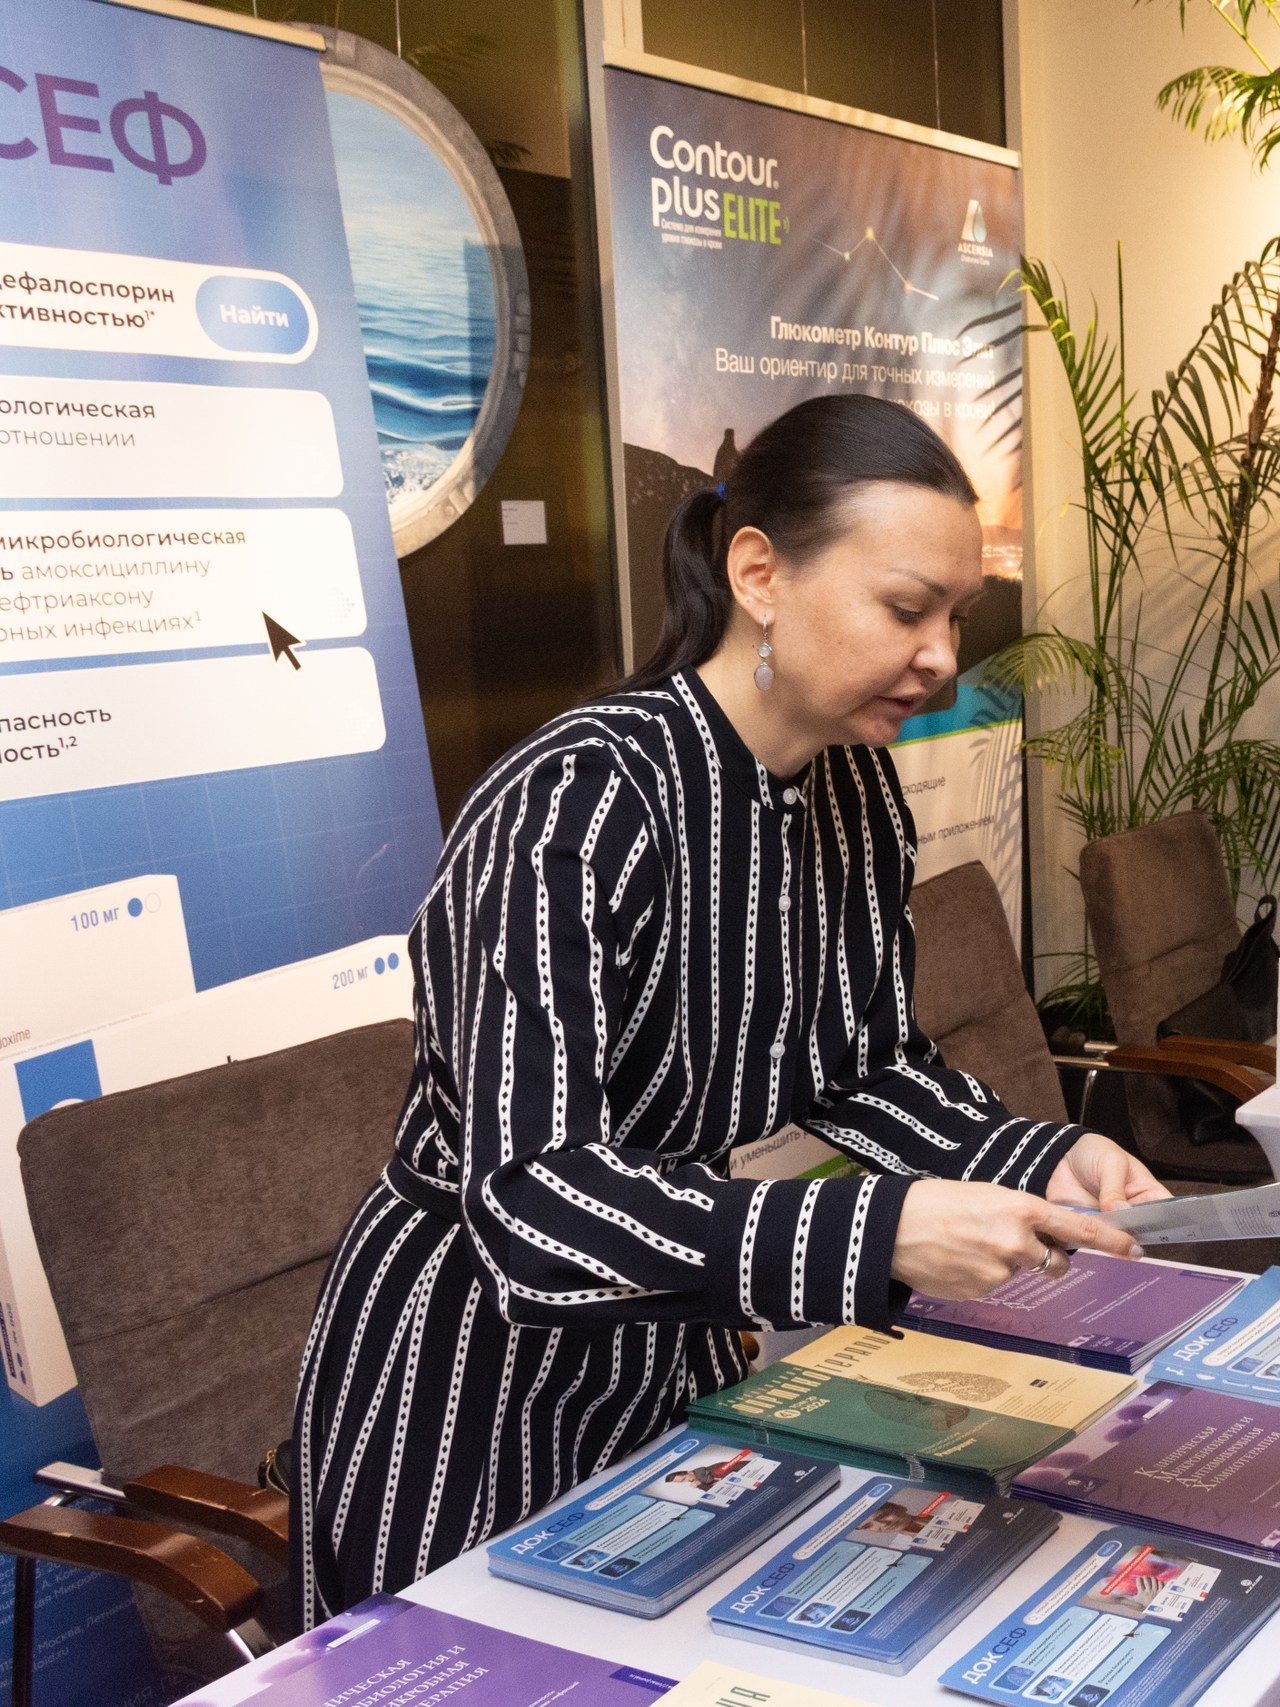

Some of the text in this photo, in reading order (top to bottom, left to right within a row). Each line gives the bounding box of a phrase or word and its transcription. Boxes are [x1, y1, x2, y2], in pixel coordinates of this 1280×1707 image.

[651, 176, 782, 245] plus ELITE
[957, 242, 994, 257] ASCENSIA
[0, 271, 175, 303] ефалоспорин
[218, 303, 290, 329] Найти
[770, 315, 861, 350] Глюкометр
[864, 325, 919, 356] Контур
[921, 331, 960, 356] Плюс
[715, 347, 996, 392] Ваш ориентир для точных измерений
[943, 401, 952, 418] в
[0, 429, 136, 447] отношении
[21, 559, 211, 581] амоксициллину
[0, 736, 78, 764] ость1,2
[70, 907, 120, 932] 100 мг
[332, 966, 369, 989] 200 мг
[0, 1028, 31, 1050] oxime
[740, 1130, 800, 1170] уменьшить
[511, 1510, 586, 1556] ДОКСЕФ
[729, 1561, 797, 1614] ДОКСЕФ
[446, 1644, 467, 1655] И
[961, 1626, 1028, 1685] ДОКСЕФ
